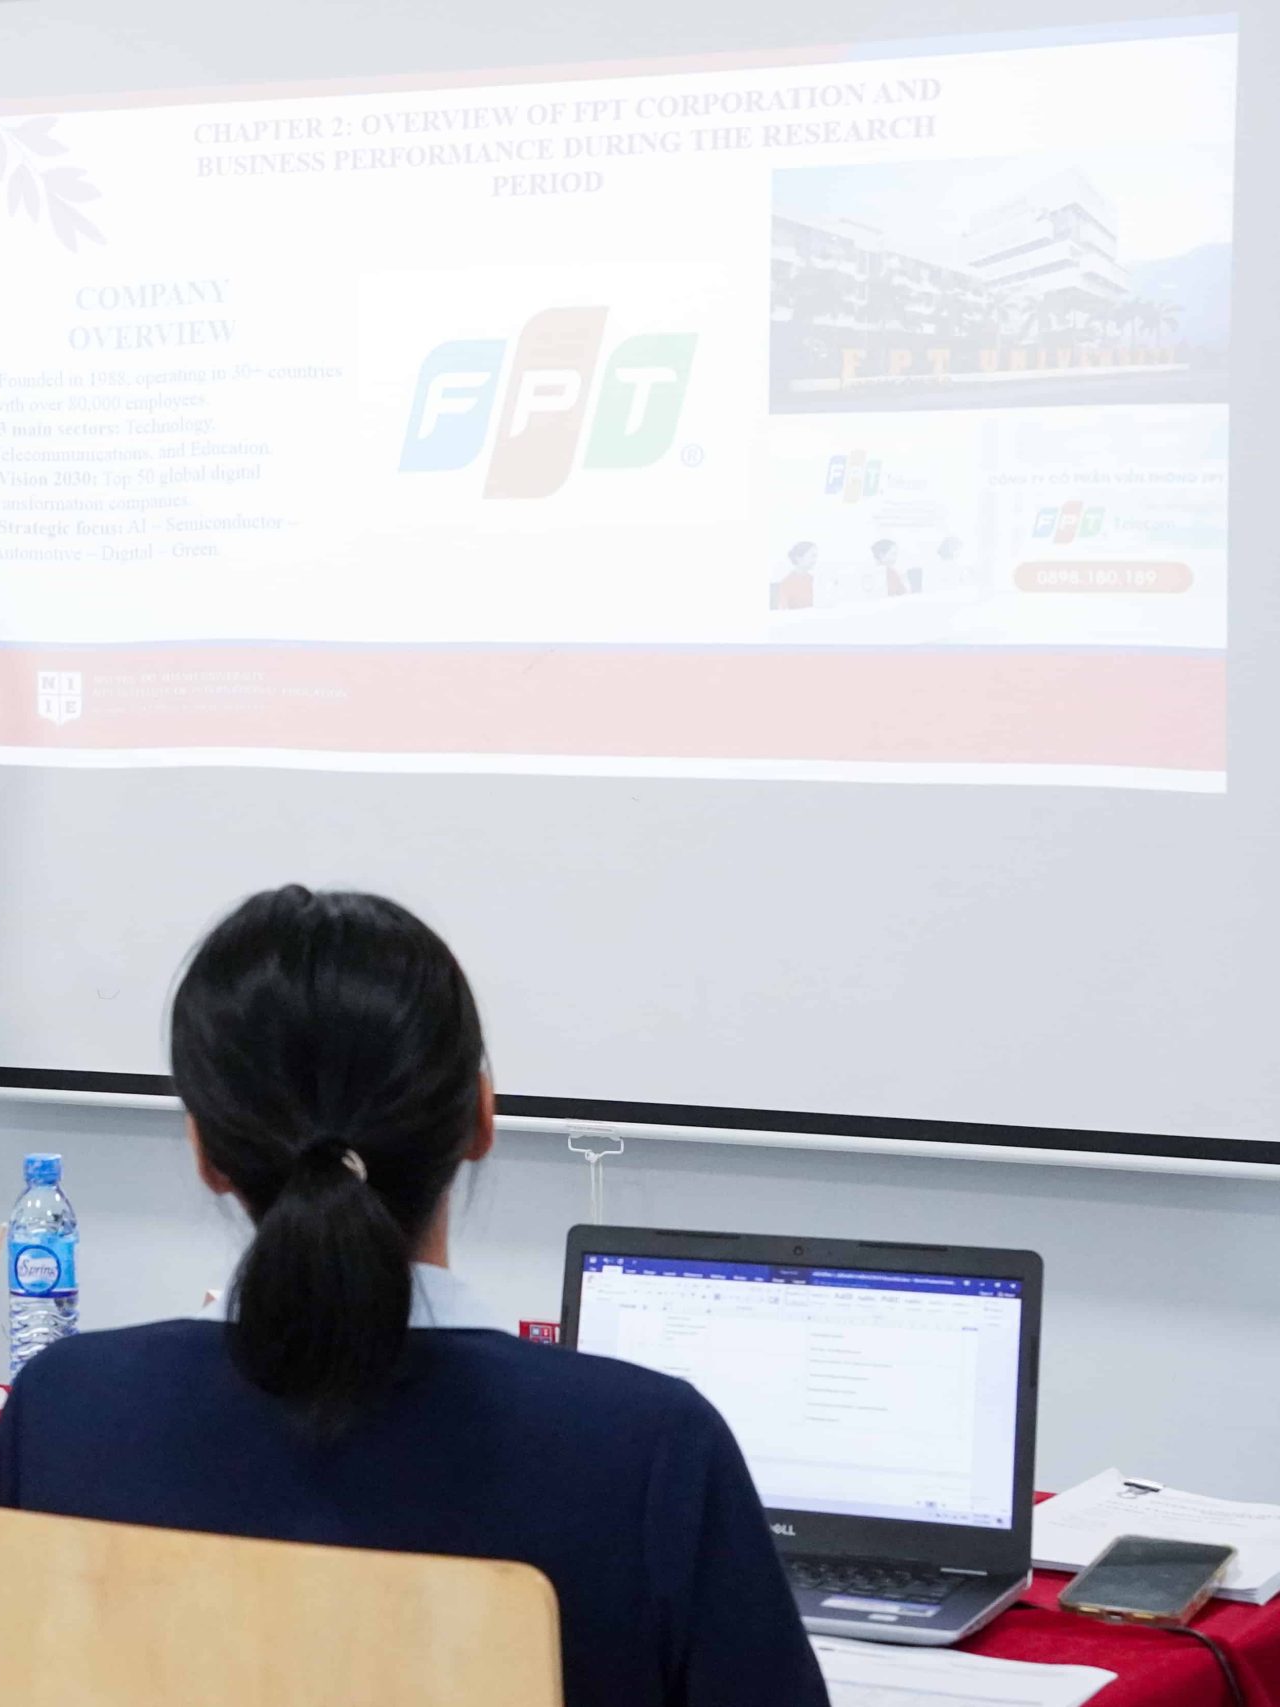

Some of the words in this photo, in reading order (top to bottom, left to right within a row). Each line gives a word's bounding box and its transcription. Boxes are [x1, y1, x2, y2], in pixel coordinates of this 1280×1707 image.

[194, 117, 323, 145] CHAPTER
[331, 115, 352, 137] 2:
[361, 104, 519, 136] OVERVIEW
[526, 101, 567, 126] OF
[574, 98, 628, 122] FPT
[635, 81, 866, 120] CORPORATION
[872, 78, 942, 104] AND
[196, 151, 326, 178] BUSINESS
[334, 137, 553, 171] PERFORMANCE
[565, 130, 681, 159] DURING
[690, 127, 752, 153] THE
[761, 115, 936, 148] RESEARCH
[491, 170, 604, 198] PERIOD
[75, 279, 230, 311] COMPANY
[67, 319, 236, 351] OVERVIEW
[135, 368, 206, 388] operating
[211, 366, 227, 381] in
[268, 360, 344, 379] countries
[29, 399, 63, 412] over
[12, 422, 52, 437] main
[58, 422, 120, 437] sectors:
[159, 442, 186, 459] and
[53, 471, 99, 487] 2030:
[103, 471, 132, 489] Top
[137, 470, 155, 485] 50
[159, 466, 206, 485] global
[211, 464, 261, 483] digital
[75, 519, 124, 536] focus:
[165, 514, 284, 532] Semiconductor
[101, 544, 153, 565] Digital
